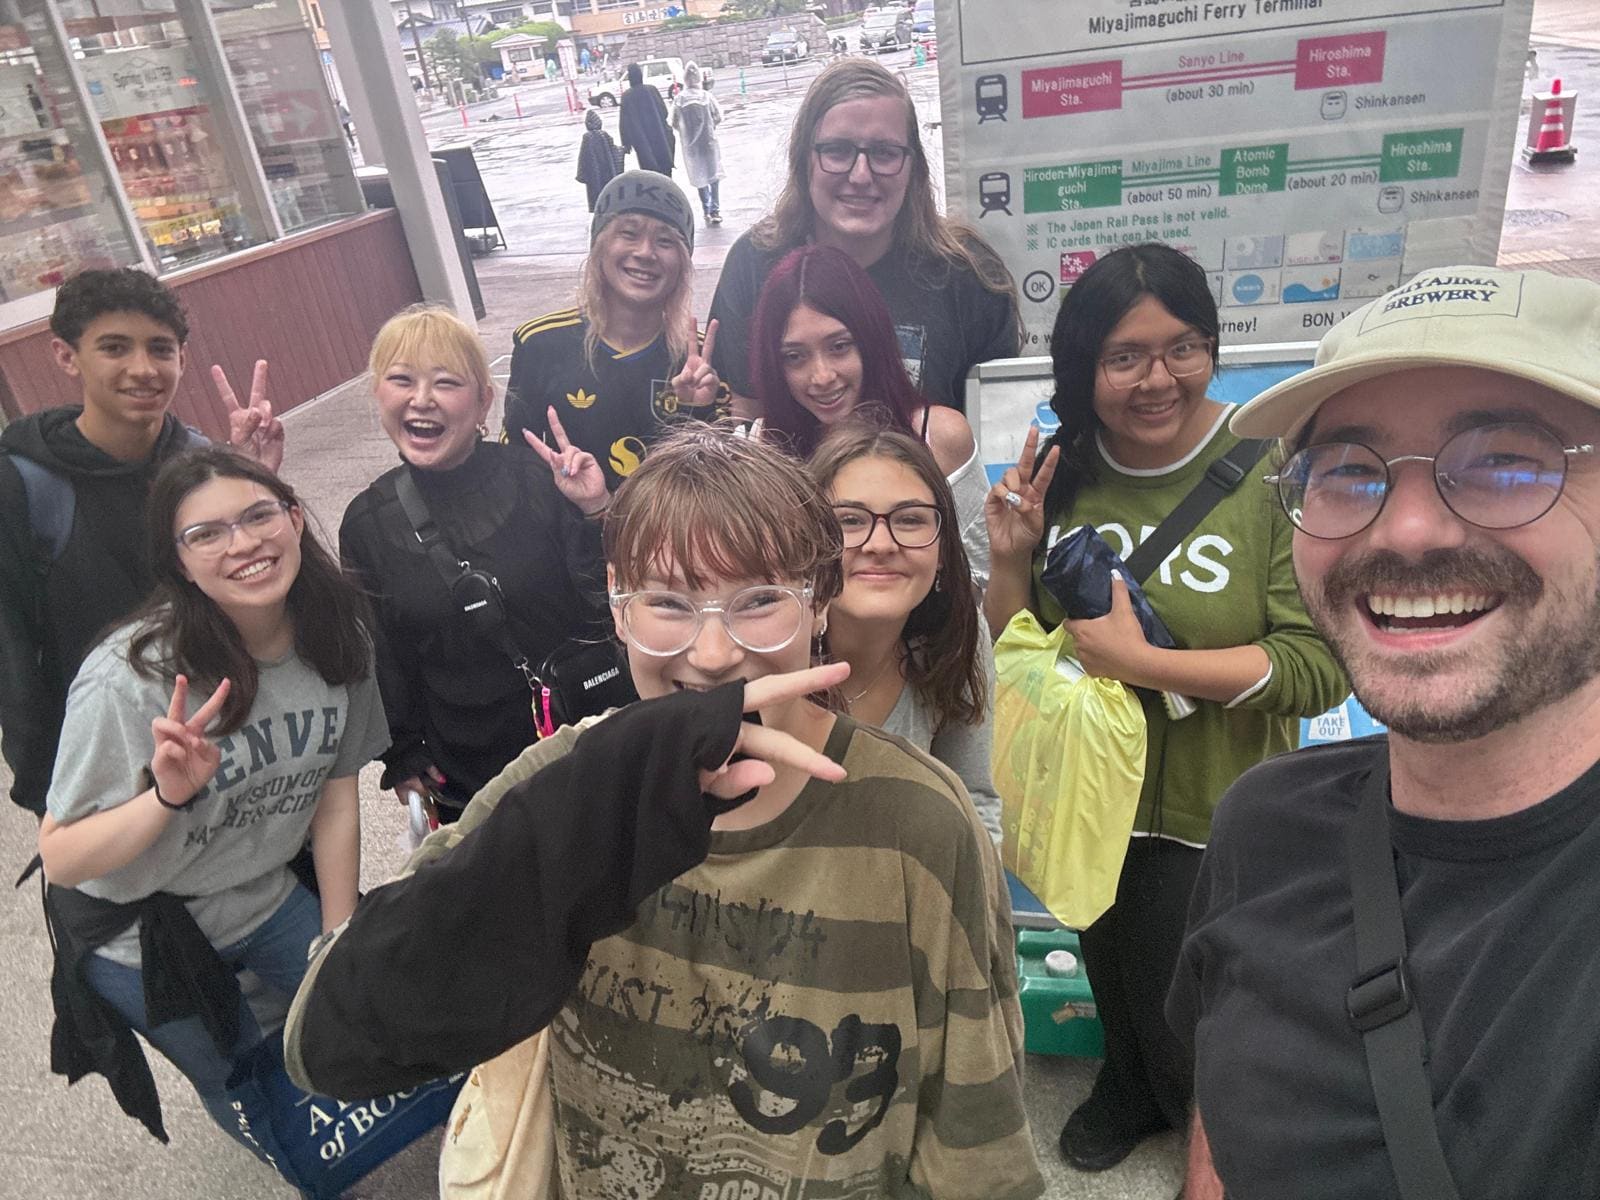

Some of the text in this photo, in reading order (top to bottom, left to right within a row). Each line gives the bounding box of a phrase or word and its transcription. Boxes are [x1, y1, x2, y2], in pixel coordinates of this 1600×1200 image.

[1088, 0, 1323, 34] Miyajimaguchi Ferry Terminal
[1178, 50, 1245, 69] Sanyo Line
[1308, 44, 1372, 62] Hiroshima
[1326, 64, 1352, 78] Sta.
[1031, 72, 1112, 93] Miyajimaguchi
[1059, 93, 1083, 106] Sta.
[1166, 80, 1254, 104] (about 30 min)
[1354, 94, 1426, 110] Shinkansen
[1233, 148, 1276, 162] Atomic
[1391, 140, 1452, 157] Hiroshima
[1132, 155, 1211, 174] Miyajima Line
[1236, 163, 1270, 178] Bomb
[1407, 158, 1431, 173] Sta.
[1236, 180, 1268, 194] Dome
[1287, 169, 1379, 191] (about 20 min)
[1057, 181, 1087, 198] guchi
[1127, 184, 1212, 205] (about 50 min)
[1410, 189, 1480, 203] Shinkansen
[1047, 221, 1066, 233] The
[1070, 219, 1103, 232] Japan
[1107, 216, 1128, 229] Rail
[1132, 213, 1159, 226] Pass
[1163, 211, 1172, 223] is
[1176, 210, 1195, 222] not
[1047, 236, 1057, 249] IC
[1061, 232, 1091, 248] cards
[1096, 230, 1118, 244] that
[1122, 229, 1141, 242] can
[1145, 227, 1158, 240] be
[1162, 226, 1192, 239] used.
[1031, 279, 1047, 293] OK
[1383, 289, 1499, 313] BREWERY
[1302, 312, 1334, 328] BON
[582, 667, 620, 691] BALENCIAGA
[1317, 717, 1345, 727] TAKE
[1319, 727, 1343, 736] OUT
[196, 707, 338, 802] ENVE
[301, 766, 328, 787] OF
[308, 1103, 334, 1137] A
[319, 1121, 346, 1160] of
